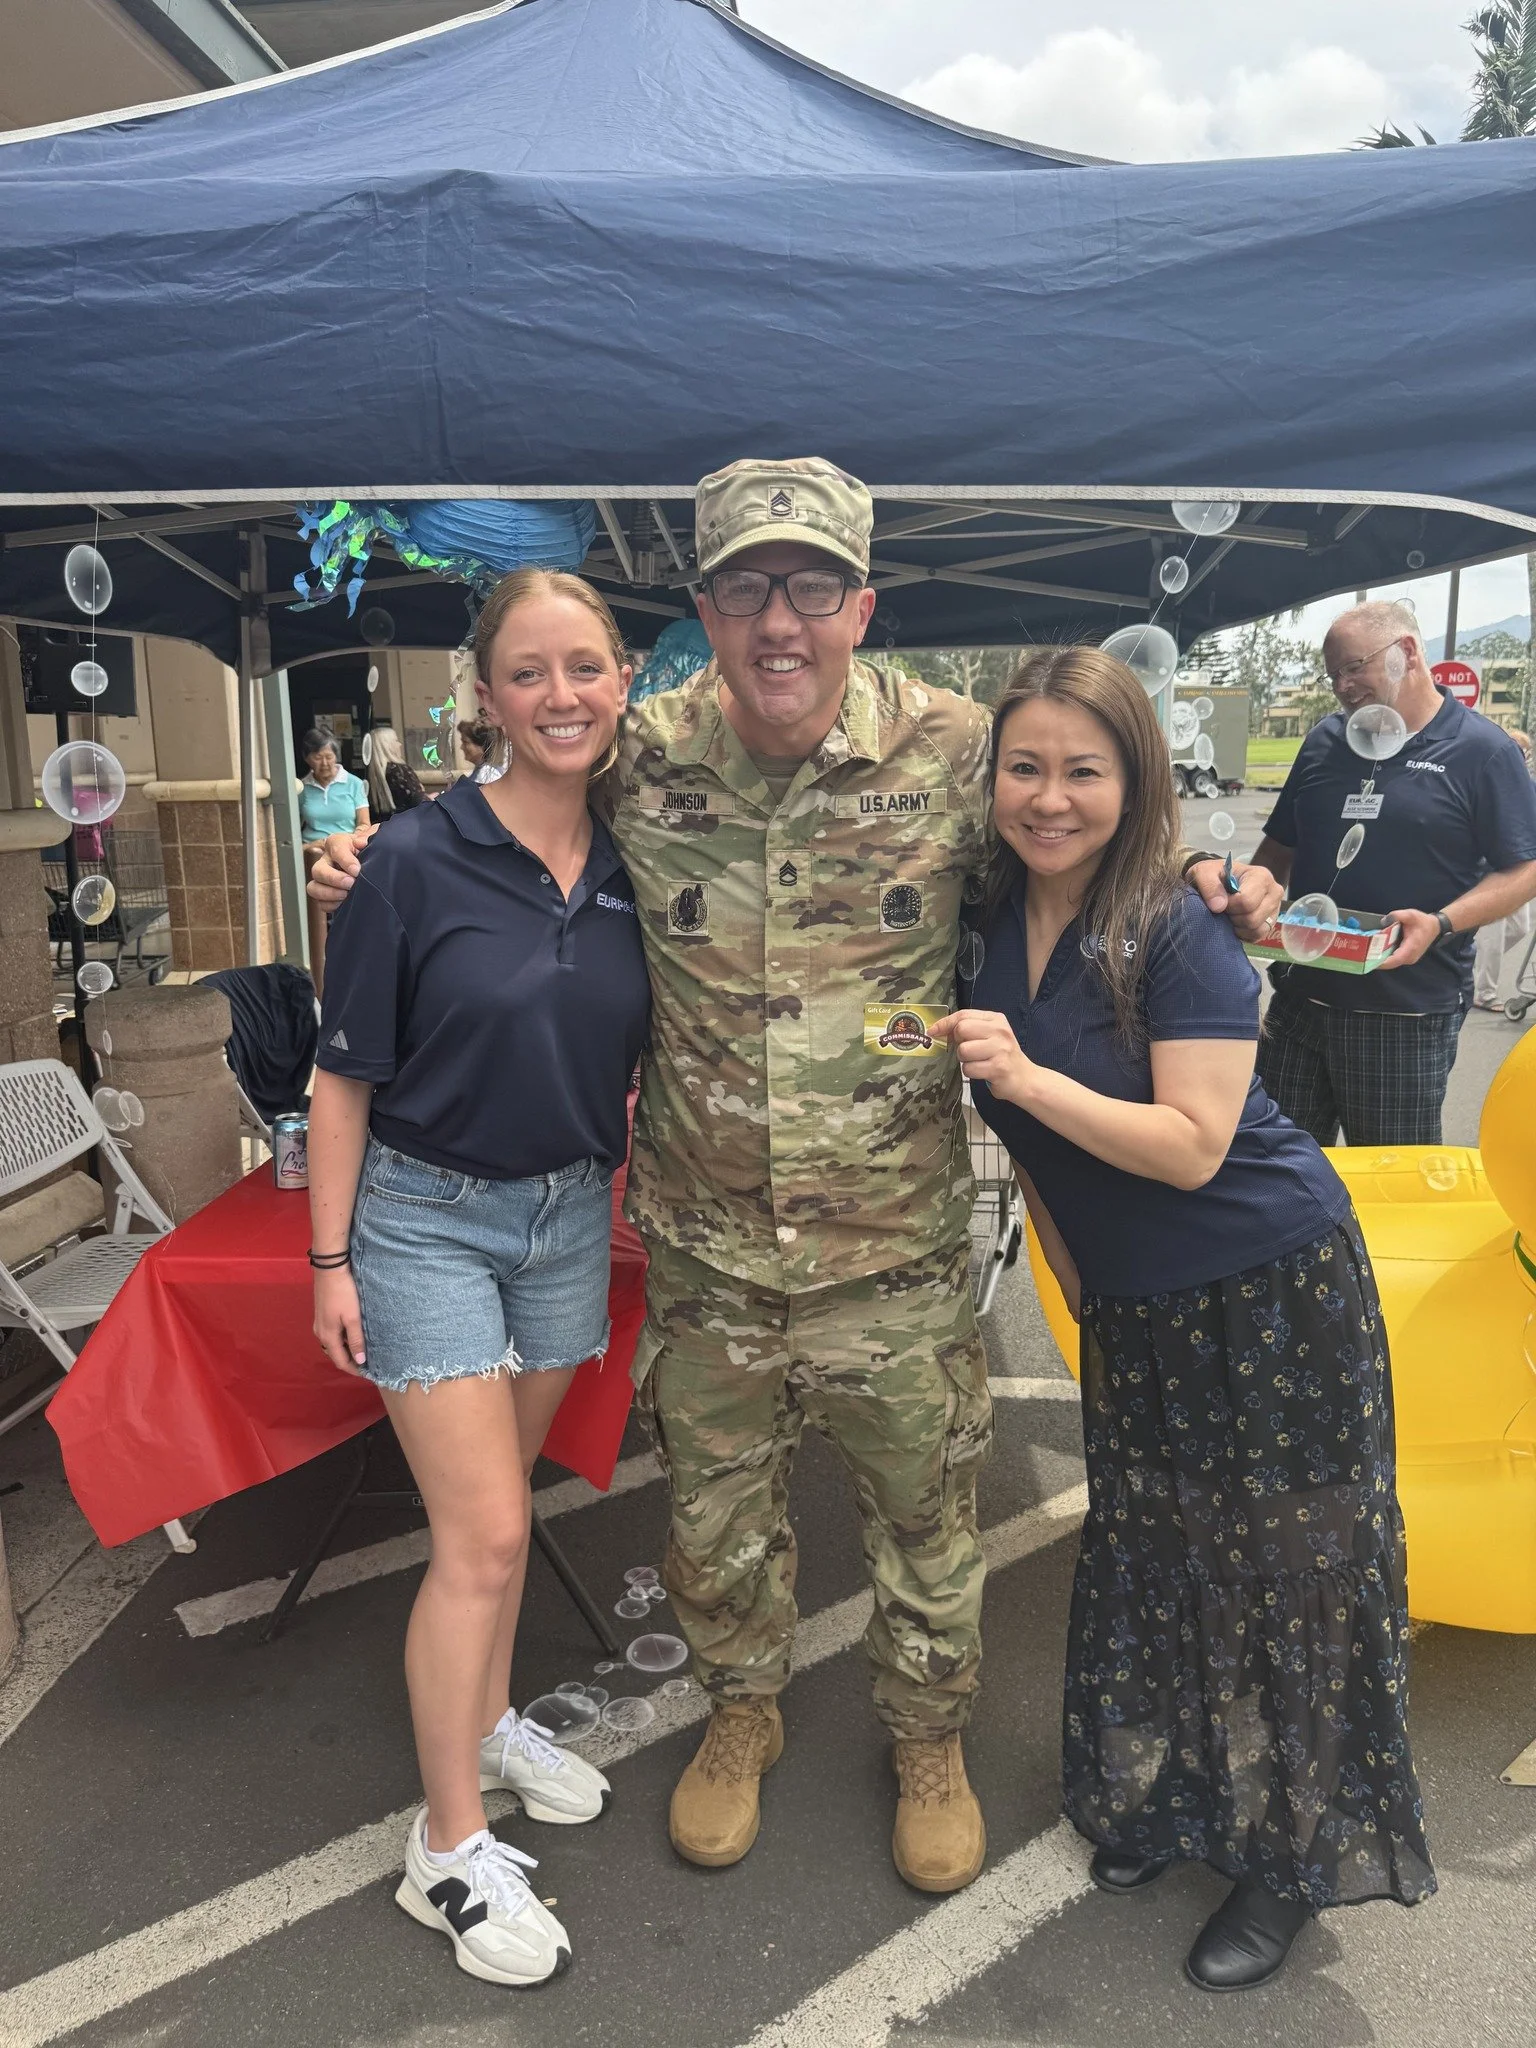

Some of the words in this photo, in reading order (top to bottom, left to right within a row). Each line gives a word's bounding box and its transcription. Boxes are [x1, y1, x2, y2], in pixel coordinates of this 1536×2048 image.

[1448, 671, 1472, 683] NOT
[662, 791, 708, 811] JOHNSON
[867, 1006, 878, 1014] Gift
[879, 1006, 891, 1014] Card
[882, 1032, 930, 1044] COMMISSARY
